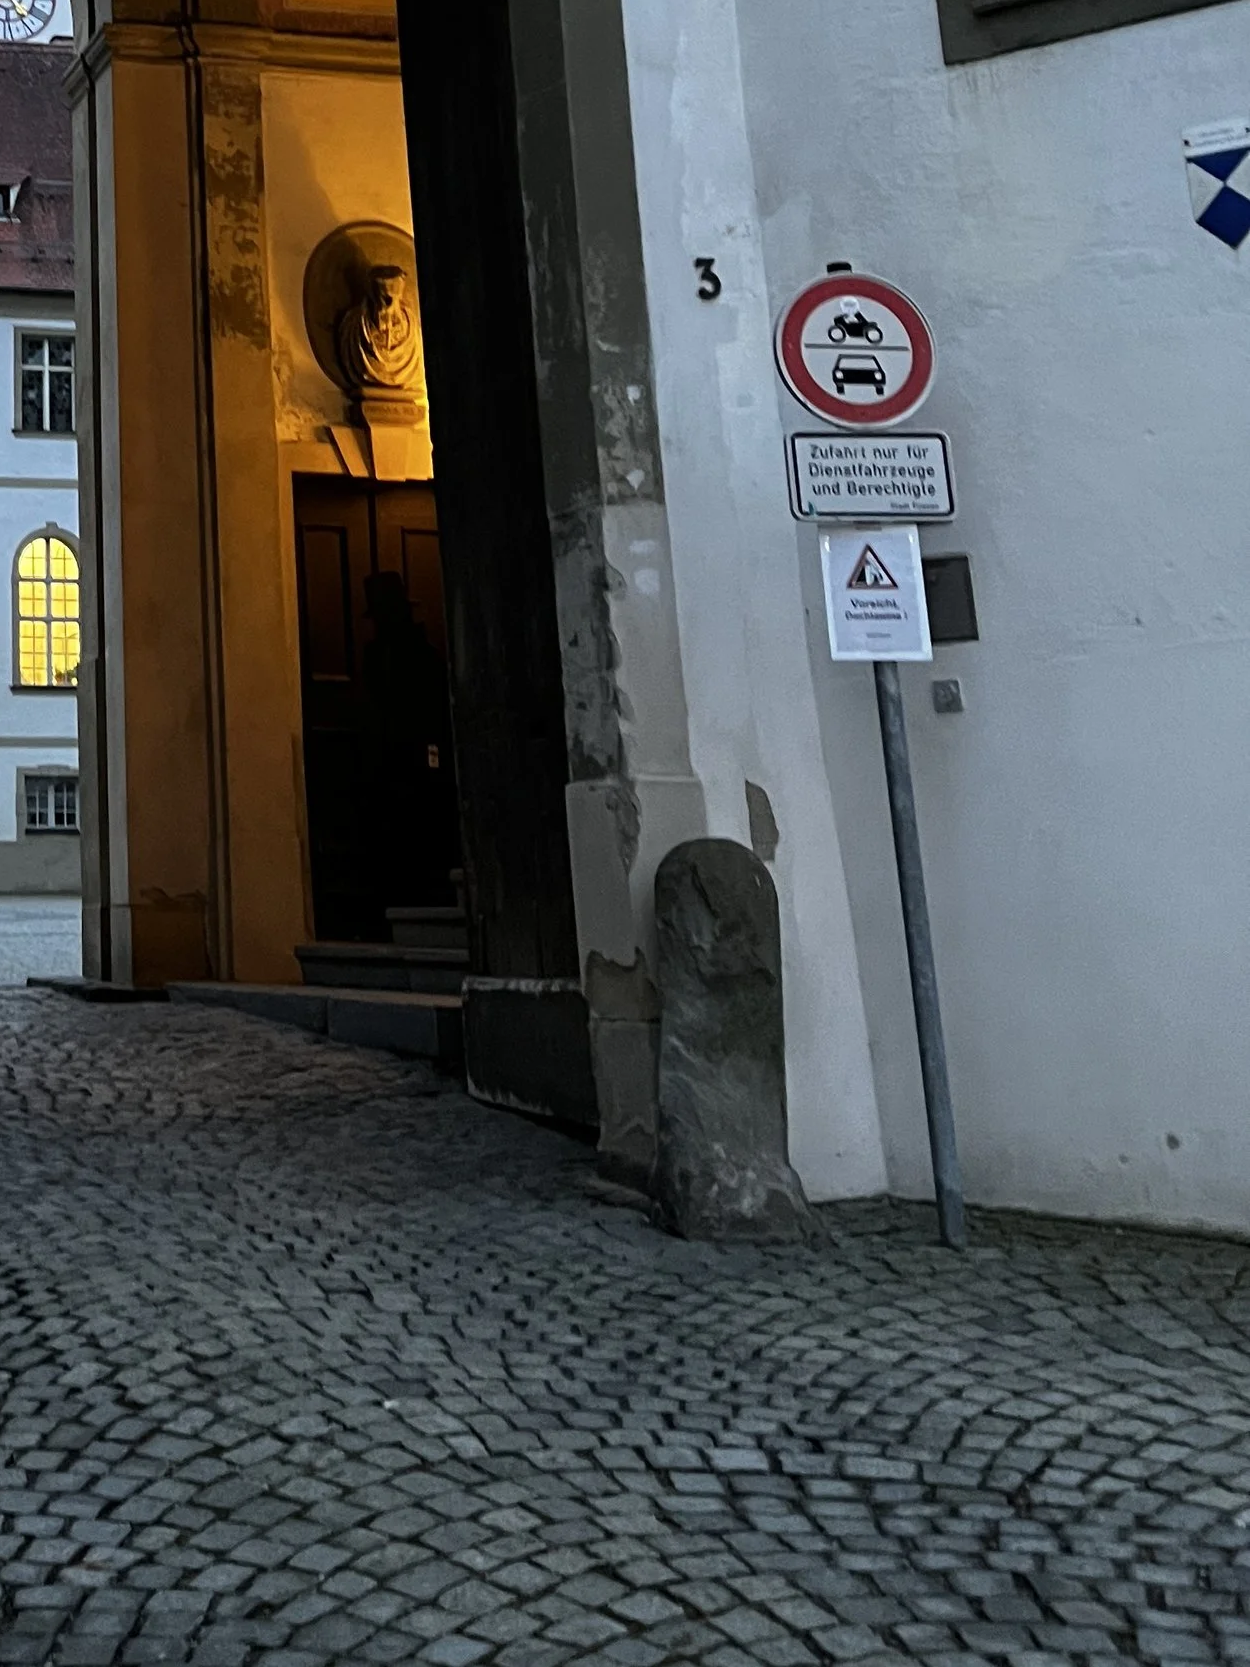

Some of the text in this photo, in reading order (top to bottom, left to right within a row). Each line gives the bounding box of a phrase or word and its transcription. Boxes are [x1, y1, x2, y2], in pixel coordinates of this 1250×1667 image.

[694, 257, 722, 301] 3
[810, 443, 929, 461] Zufahrt nur für
[808, 462, 936, 481] Dienstfahrzeuge
[812, 480, 937, 499] und Berechtigte
